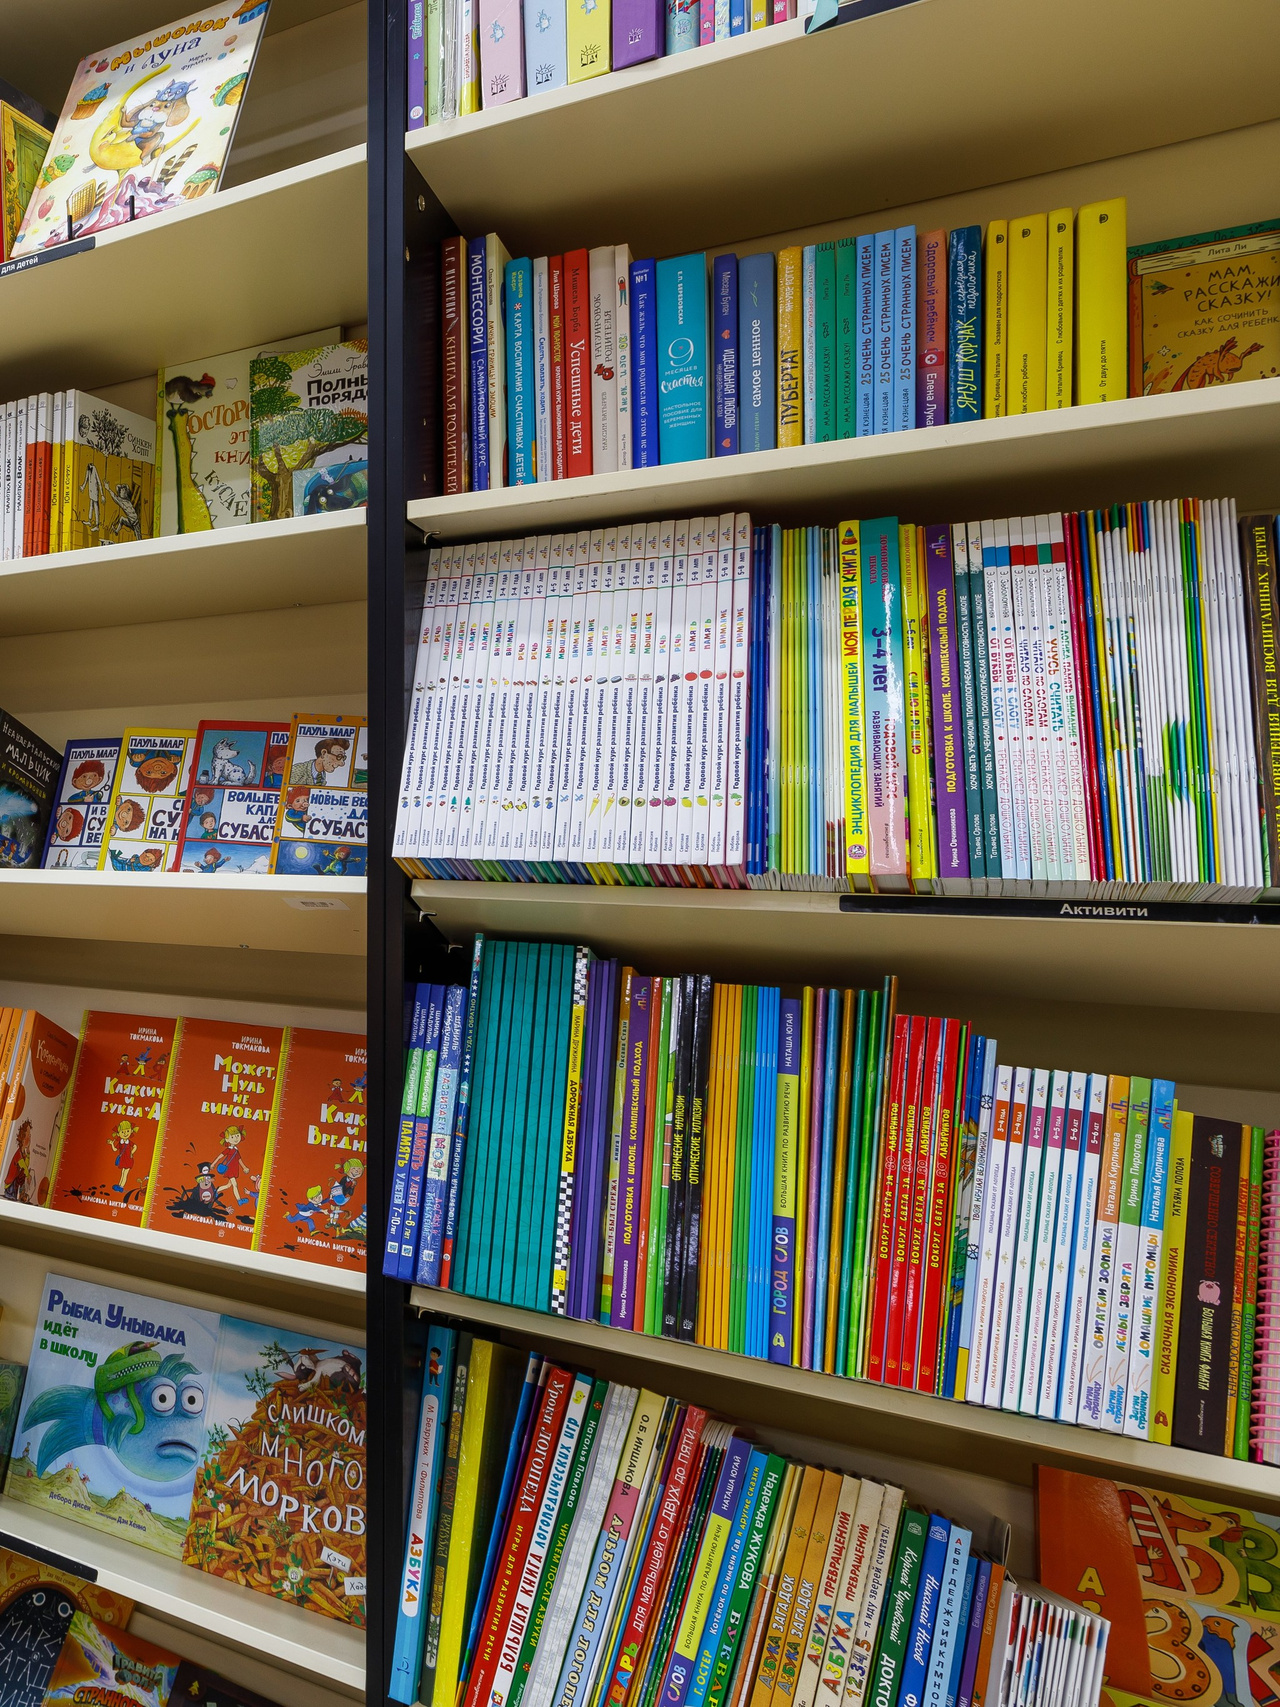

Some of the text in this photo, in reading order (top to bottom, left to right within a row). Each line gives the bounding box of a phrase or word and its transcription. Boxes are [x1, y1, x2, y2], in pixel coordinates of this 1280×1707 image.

[1, 264, 15, 277] для
[17, 257, 39, 273] детей
[926, 241, 938, 296] Здоровый
[1207, 244, 1247, 256] Лита Ли
[1184, 276, 1280, 301] РАССКАЖИ
[1208, 264, 1256, 282] МАМ,
[471, 255, 483, 345] МОНТЕССОРИ
[861, 245, 872, 371] ОЧЕНЬ СТРАННЫХ ПИСЕМ
[880, 243, 891, 369] ОЧЕНЬ СТРАННЫХ ПИСЕМ
[901, 238, 911, 366] ОЧЕНЬ СТРАННЫХ ПИСЕМ
[1194, 308, 1268, 326] КАК СОЧИНИТЬ
[1197, 290, 1272, 312] СКАЗКУ!
[668, 337, 694, 368] 9
[1177, 323, 1239, 338] СКАЗКУ ДЛЯ
[661, 374, 703, 394] Счастья
[665, 365, 697, 376] МЕСЯЦЕВ
[751, 319, 762, 407] самое ценное
[571, 339, 585, 454] Успешные дети
[663, 401, 701, 411] НАСТОЛЬНОЕ
[781, 349, 799, 426] ПУБЕРТАТ
[926, 373, 937, 402] Елена
[445, 336, 457, 493] КНИГА ДЛЯ РОДИТЕЛЕЙ
[515, 392, 523, 449] СЧАСТЛИВЫХ
[663, 413, 701, 424] БЕРЕМЕННЫХ
[668, 420, 695, 428] ЖЕНЩИН
[516, 451, 524, 479] ДЕТЕЙ
[1254, 526, 1276, 683] ВОСПИТАННЫХ ДЕТЕЙ
[842, 548, 863, 835] ЭНЦИКЛОПЕДИЯ ДЛЯ МАЛЫШЕЙ МОЯ КНИГА
[938, 589, 956, 793] ПОДГОТОВКА КОМПЛЕКСНЫЙ ПОДХОД
[70, 748, 117, 759] ПАУЛЬ МААР
[130, 738, 184, 748] ПАУЛЬ МААР
[298, 726, 356, 737] ПАУЛЬ МААР
[6, 744, 51, 784] МАЛЬЧИК
[311, 794, 350, 806] НОВЫЕ
[1060, 903, 1148, 916] Активити
[130, 1033, 163, 1043] ТОКМАКОВА
[138, 1027, 157, 1036] ИРИНА
[232, 1042, 271, 1054] ТОКМАКОВА
[241, 1035, 263, 1045] ИРИНА
[785, 1036, 793, 1067] НАТАША
[100, 1102, 144, 1118] БУКВА
[566, 1080, 577, 1162] ДОРОЖНАЯ АЗБУКА
[397, 1120, 413, 1167] ПАМЯТЬ
[624, 1041, 643, 1245] ПОДГОТОВКА КОМПЛЕКСНЫЙ ПОДХОД
[1127, 1134, 1143, 1207] Ирина Пирогова
[1149, 1137, 1166, 1222] Наталья Кирпичева
[1172, 1157, 1185, 1217] ТАТЬЯНА ПОПОВА
[773, 1270, 787, 1315] ГОРОД
[1093, 1228, 1113, 1349] ОБИТАТЕЛИ ЗООПАРКА
[1116, 1263, 1132, 1353] ЛЕСНЫЕ ЗВЕРЯТА
[1160, 1247, 1179, 1375] СКАЗОЧНАЯ ЭКОНОМИКА
[43, 1319, 78, 1340] идёт
[1139, 1294, 1153, 1358] ДОМАШНИЕ
[40, 1339, 98, 1369] в школу
[267, 1404, 365, 1447] СЛИШКОМ
[260, 1432, 364, 1491] МНОГО
[48, 1491, 71, 1507] Дебора
[739, 1471, 779, 1589] Надежда ЖУКОВА
[405, 1533, 423, 1603] АЗБУКА
[824, 1511, 851, 1598] ПРЕВРАЩЕНИЙ
[846, 1524, 869, 1601] ПРЕВРАЩЕНИЙ
[500, 1554, 543, 1673] БОЛЬШАЯ КНИГА
[772, 1574, 796, 1633] ЗАГАДОК
[791, 1579, 815, 1639] ЗАГАДОК
